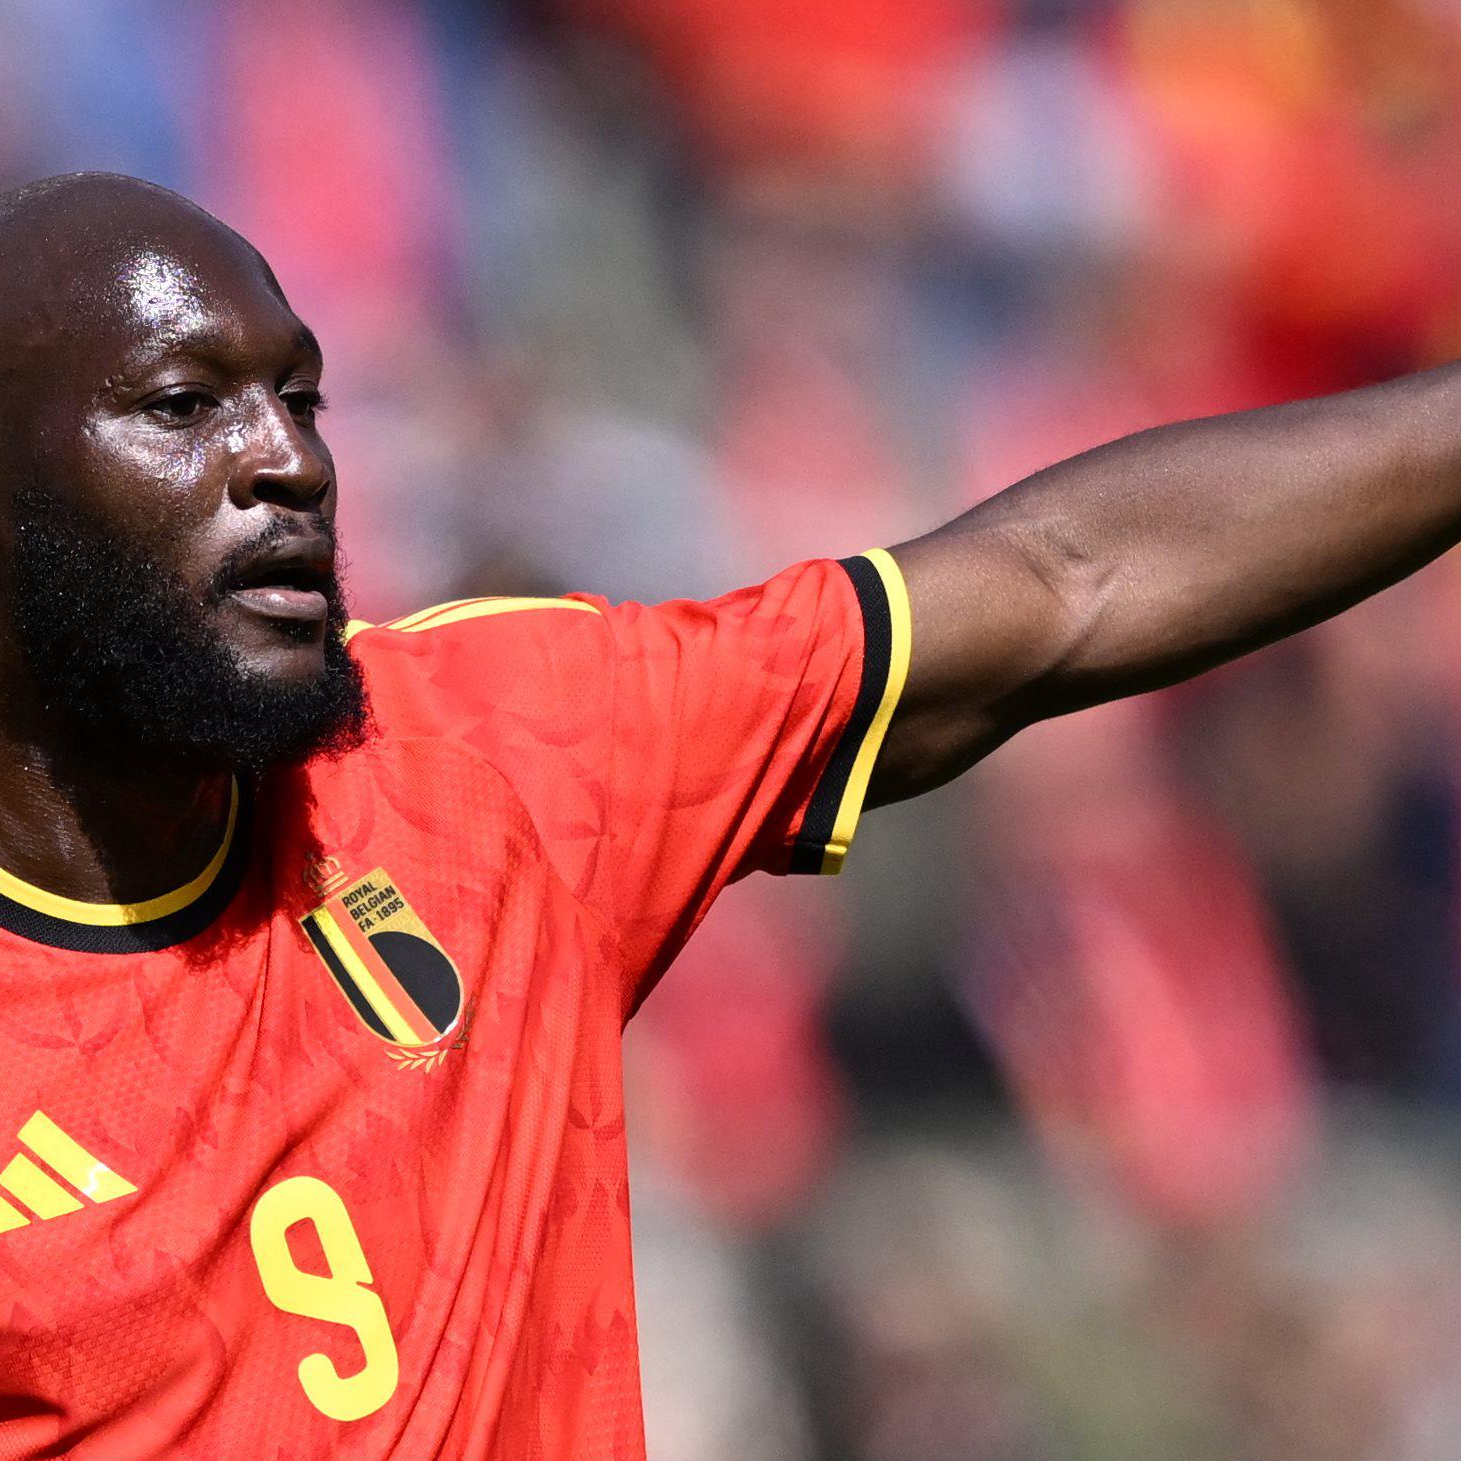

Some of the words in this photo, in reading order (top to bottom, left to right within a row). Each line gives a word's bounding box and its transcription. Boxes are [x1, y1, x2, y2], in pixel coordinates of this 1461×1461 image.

[342, 881, 377, 908] ROYAL
[350, 885, 396, 920] BELGIAN
[250, 1176, 399, 1422] 9
